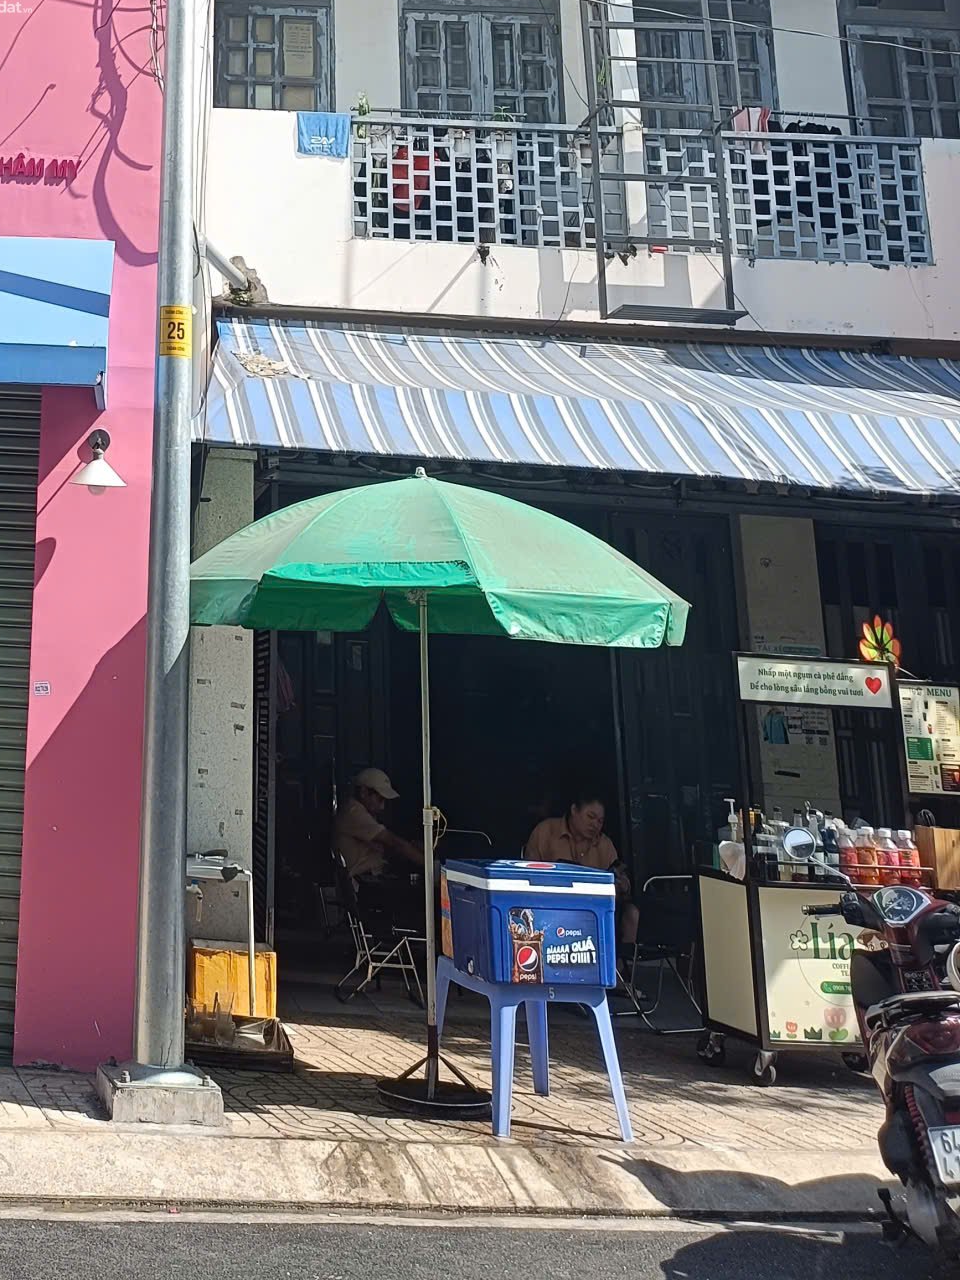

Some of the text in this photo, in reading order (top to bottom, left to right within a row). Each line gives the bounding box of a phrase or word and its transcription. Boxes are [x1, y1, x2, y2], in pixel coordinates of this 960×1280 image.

[167, 321, 185, 340] 25
[778, 670, 792, 679] một
[760, 683, 773, 691] cho
[774, 683, 789, 694] lòng
[790, 684, 803, 693] sâu
[837, 688, 849, 696] vui
[926, 688, 952, 697] MENU
[565, 929, 582, 937] pepsi
[571, 936, 596, 952] QUÁ
[546, 953, 569, 964] PEPSI
[519, 973, 537, 981] pepsi
[548, 986, 555, 999] 5
